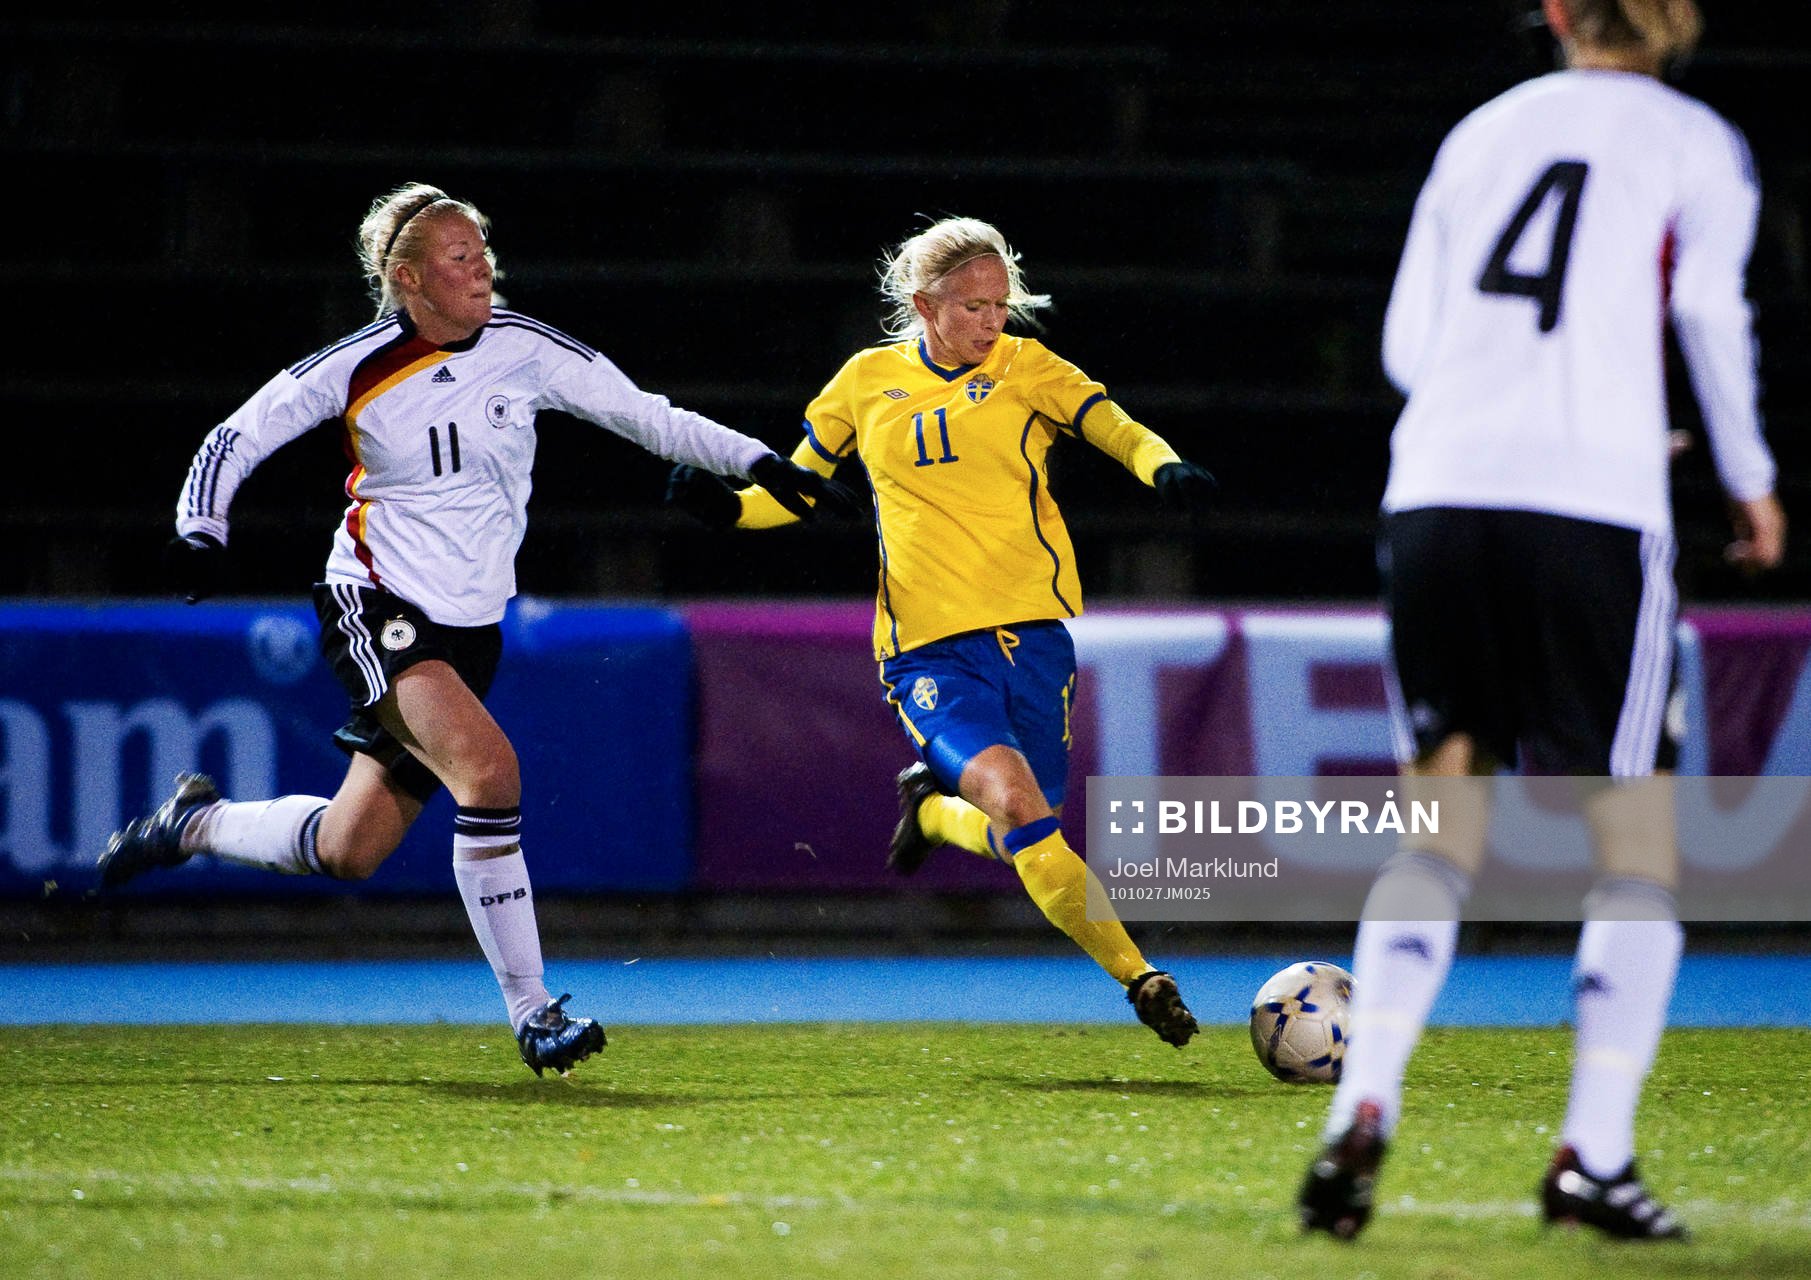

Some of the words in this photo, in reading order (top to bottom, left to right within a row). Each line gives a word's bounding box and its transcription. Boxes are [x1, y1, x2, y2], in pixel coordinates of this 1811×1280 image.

[1477, 160, 1589, 332] 4
[429, 421, 461, 477] 11
[911, 407, 960, 467] 11
[479, 887, 527, 907] DFB
